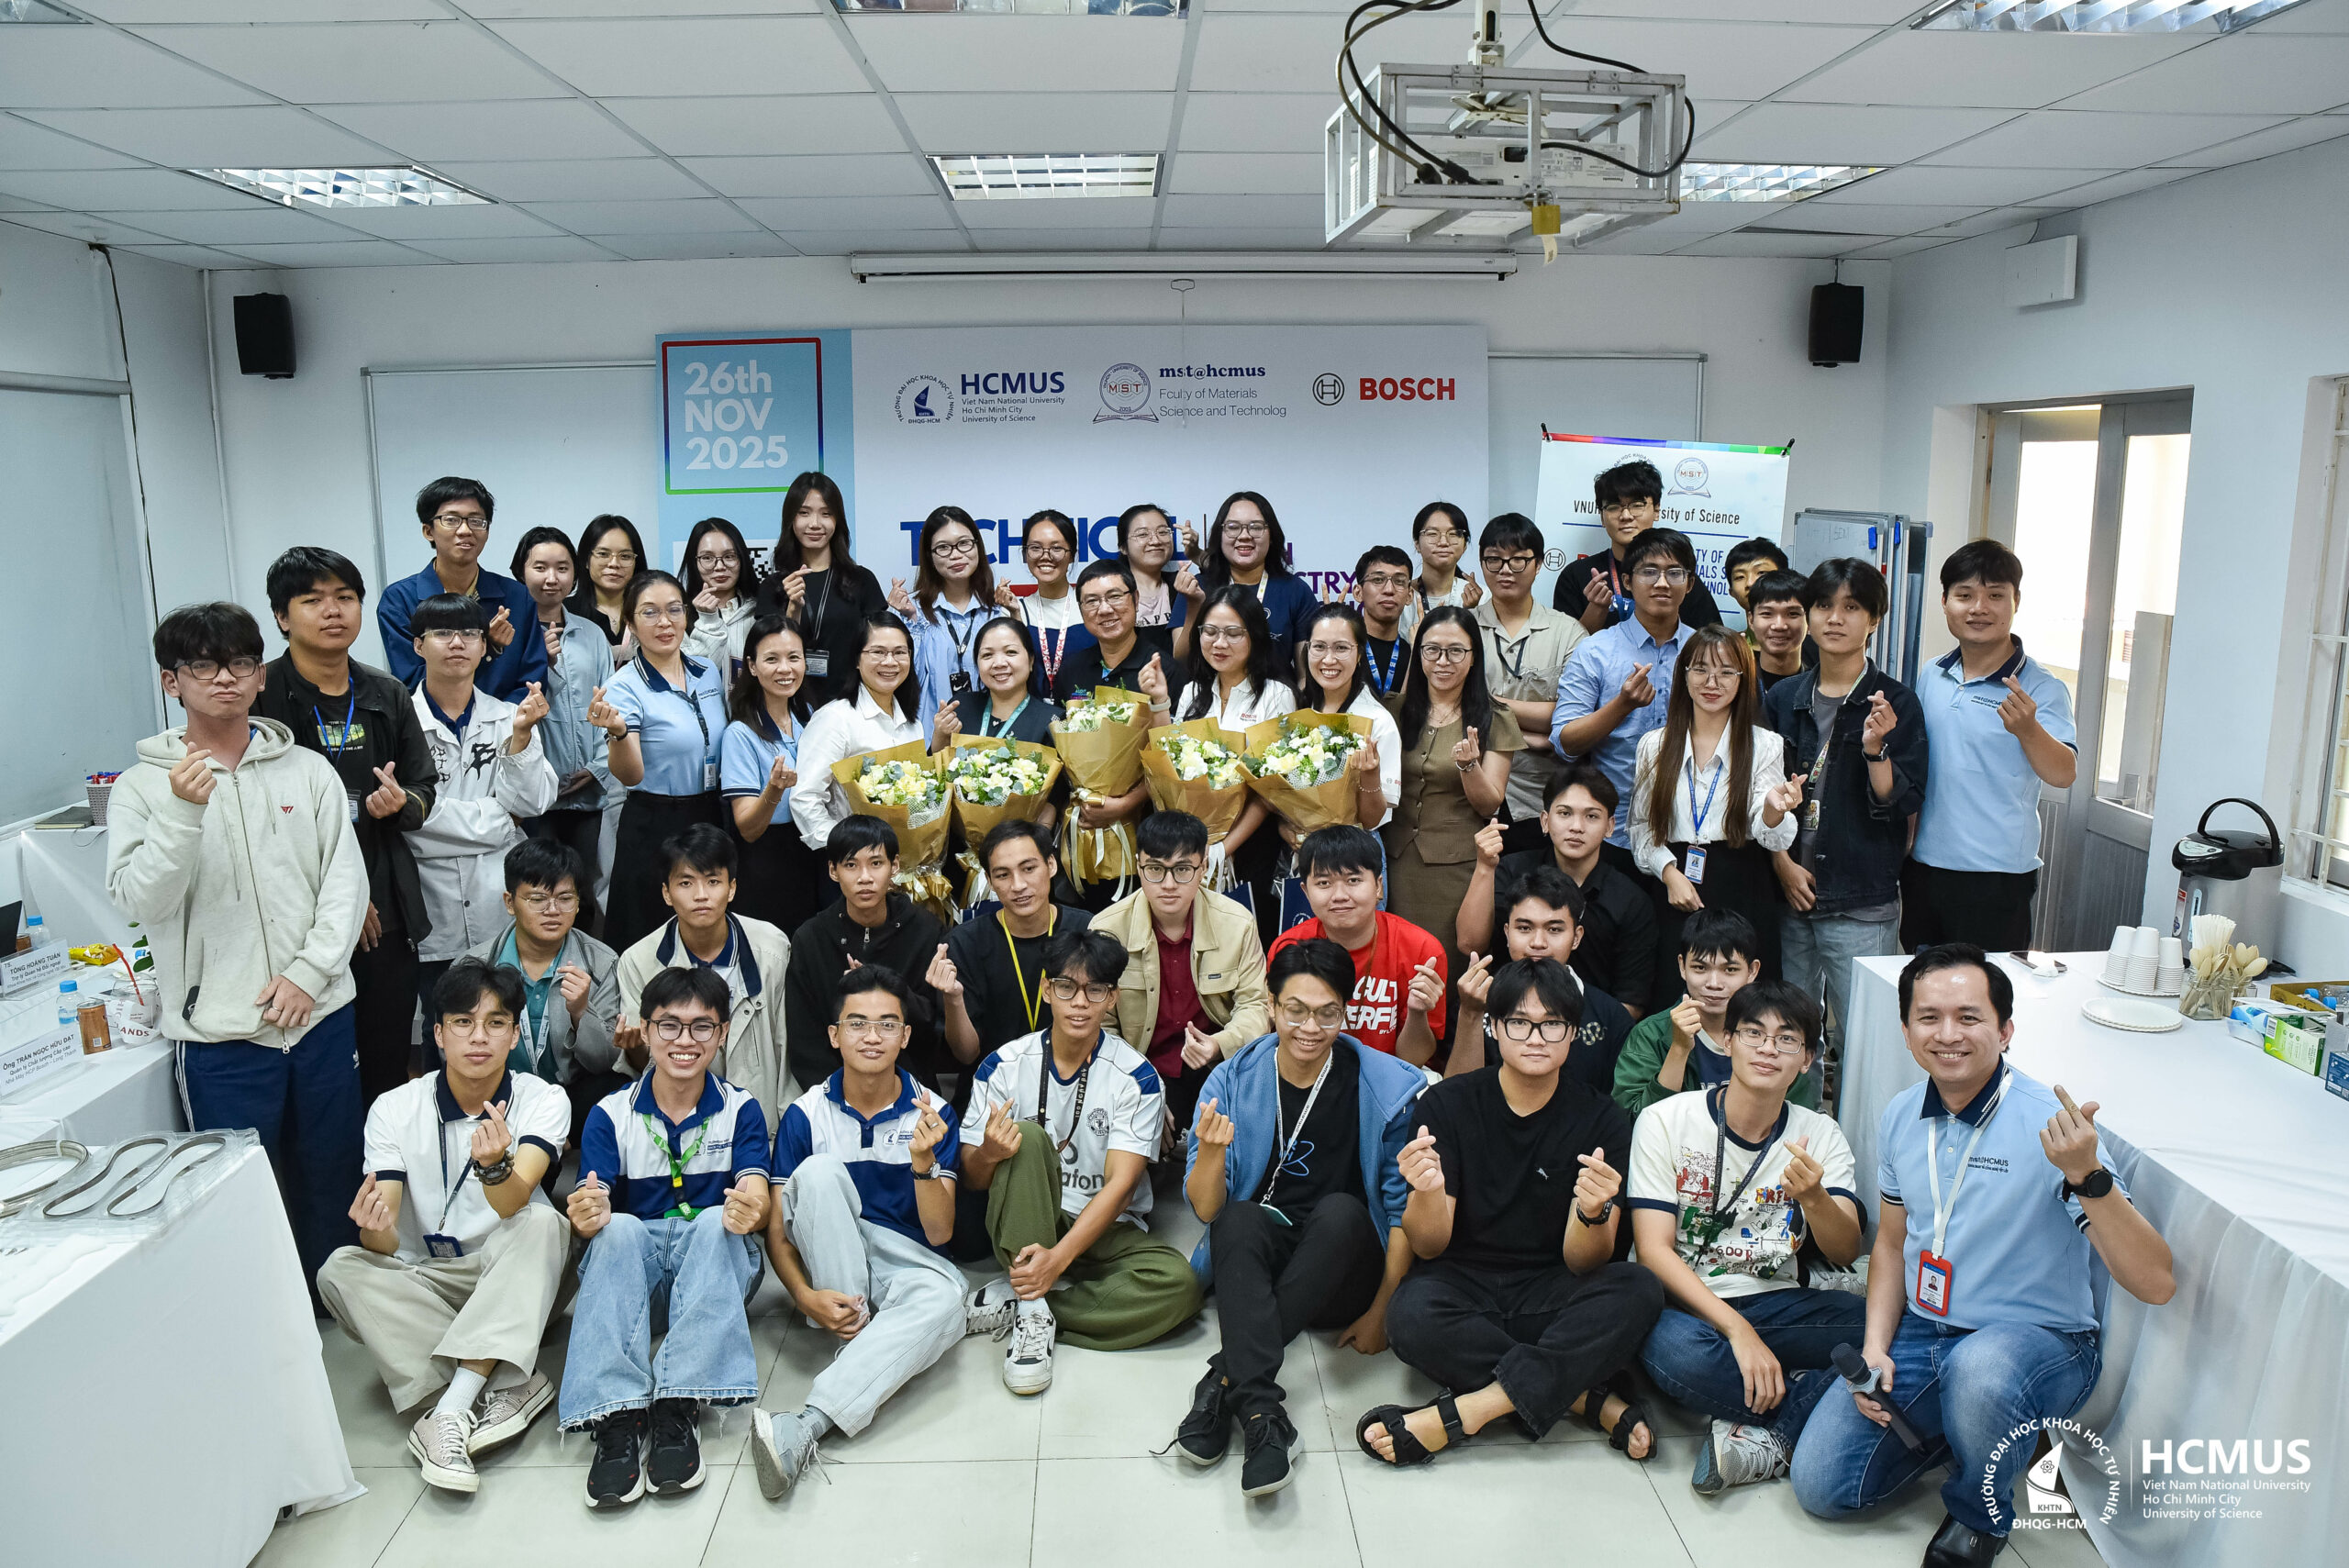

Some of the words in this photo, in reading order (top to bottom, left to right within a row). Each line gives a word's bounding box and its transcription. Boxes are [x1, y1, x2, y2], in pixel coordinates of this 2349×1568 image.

[685, 360, 772, 395] 26th
[1159, 364, 1266, 380] mst@hcmus
[961, 372, 1065, 395] HCMUS
[1359, 377, 1455, 401] BOSCH
[1195, 388, 1207, 399] of
[1208, 388, 1258, 399] Materials
[997, 396, 1028, 405] National
[1030, 396, 1065, 406] University
[685, 398, 774, 432] NOV
[1008, 406, 1023, 415] City
[1159, 406, 1205, 417] Science
[1206, 406, 1230, 417] and
[1230, 406, 1287, 418] Technolog
[962, 416, 998, 424] University
[685, 436, 788, 470] 2025
[1685, 509, 1695, 522] of
[1698, 508, 1741, 525] Science
[1711, 550, 1724, 563] OF
[3, 1062, 16, 1071] Ông
